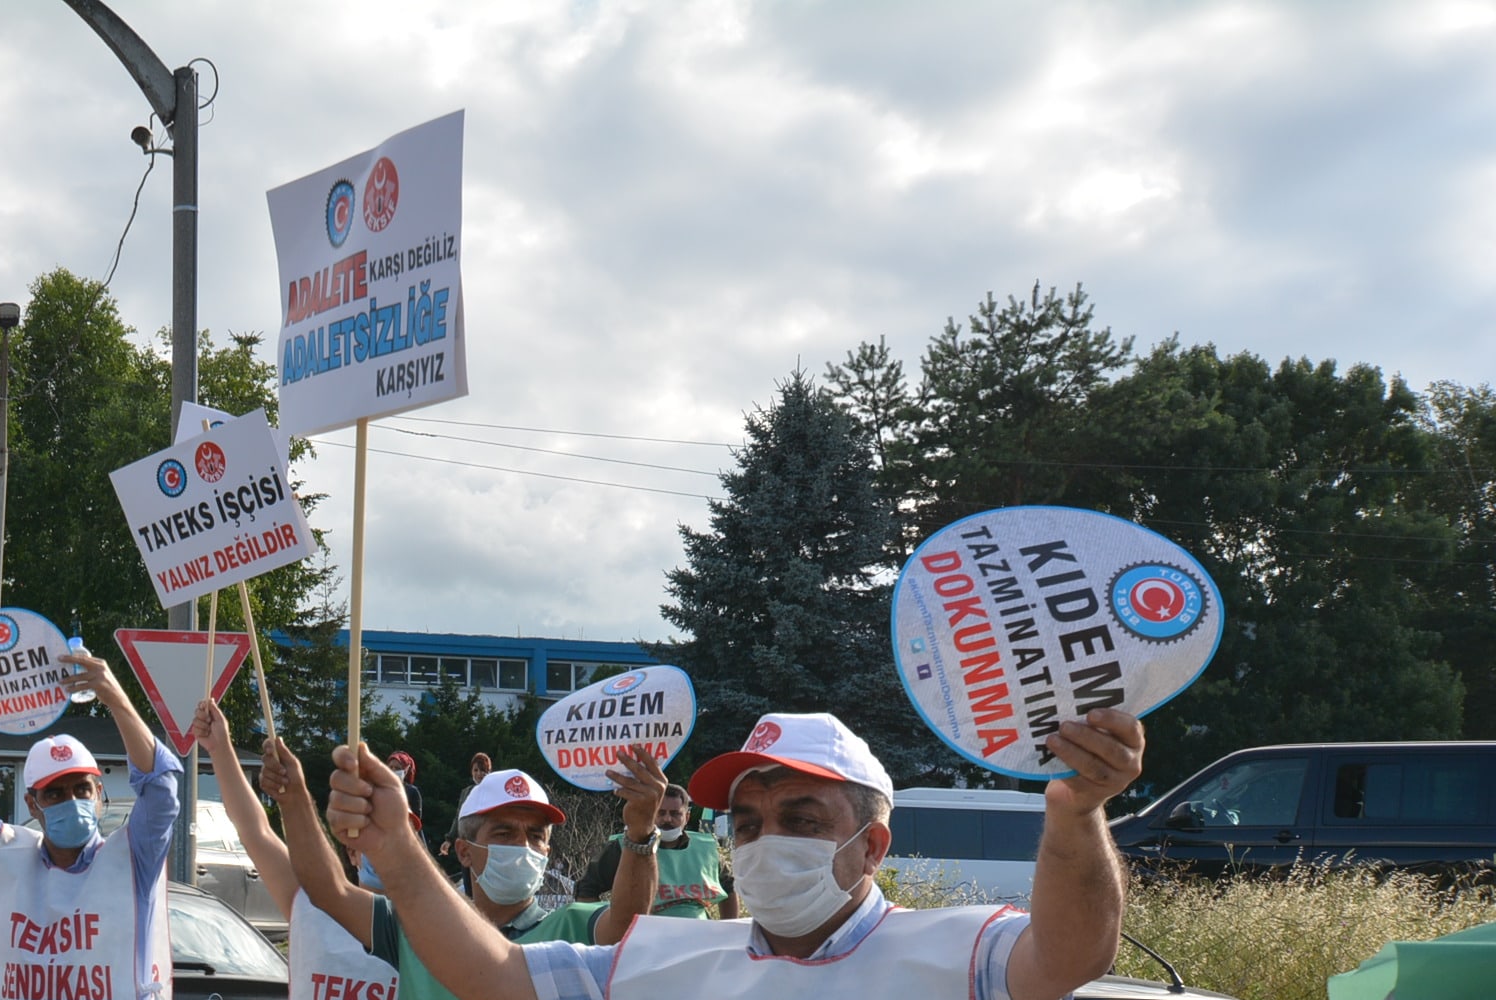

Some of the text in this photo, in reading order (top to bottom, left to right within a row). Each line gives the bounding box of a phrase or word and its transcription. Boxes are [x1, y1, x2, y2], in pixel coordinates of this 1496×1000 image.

[285, 232, 457, 327] ADALETE KARŞI DEĞİLİZ,
[282, 278, 449, 386] ADALETSİZLİĞE
[376, 352, 445, 399] KARŞIYIZ
[138, 466, 285, 552] TAYEKS İŞÇİSİ
[157, 522, 298, 594] YALNIZ DEĞİLDİR
[920, 550, 1019, 758] DOKUNMA
[960, 525, 1060, 767] TAZMİNATIMA
[1019, 540, 1125, 716] KIDEM
[545, 722, 683, 744] TAZMİNATIMA
[566, 691, 664, 722] KIDEM
[10, 908, 100, 955] TEKSİF
